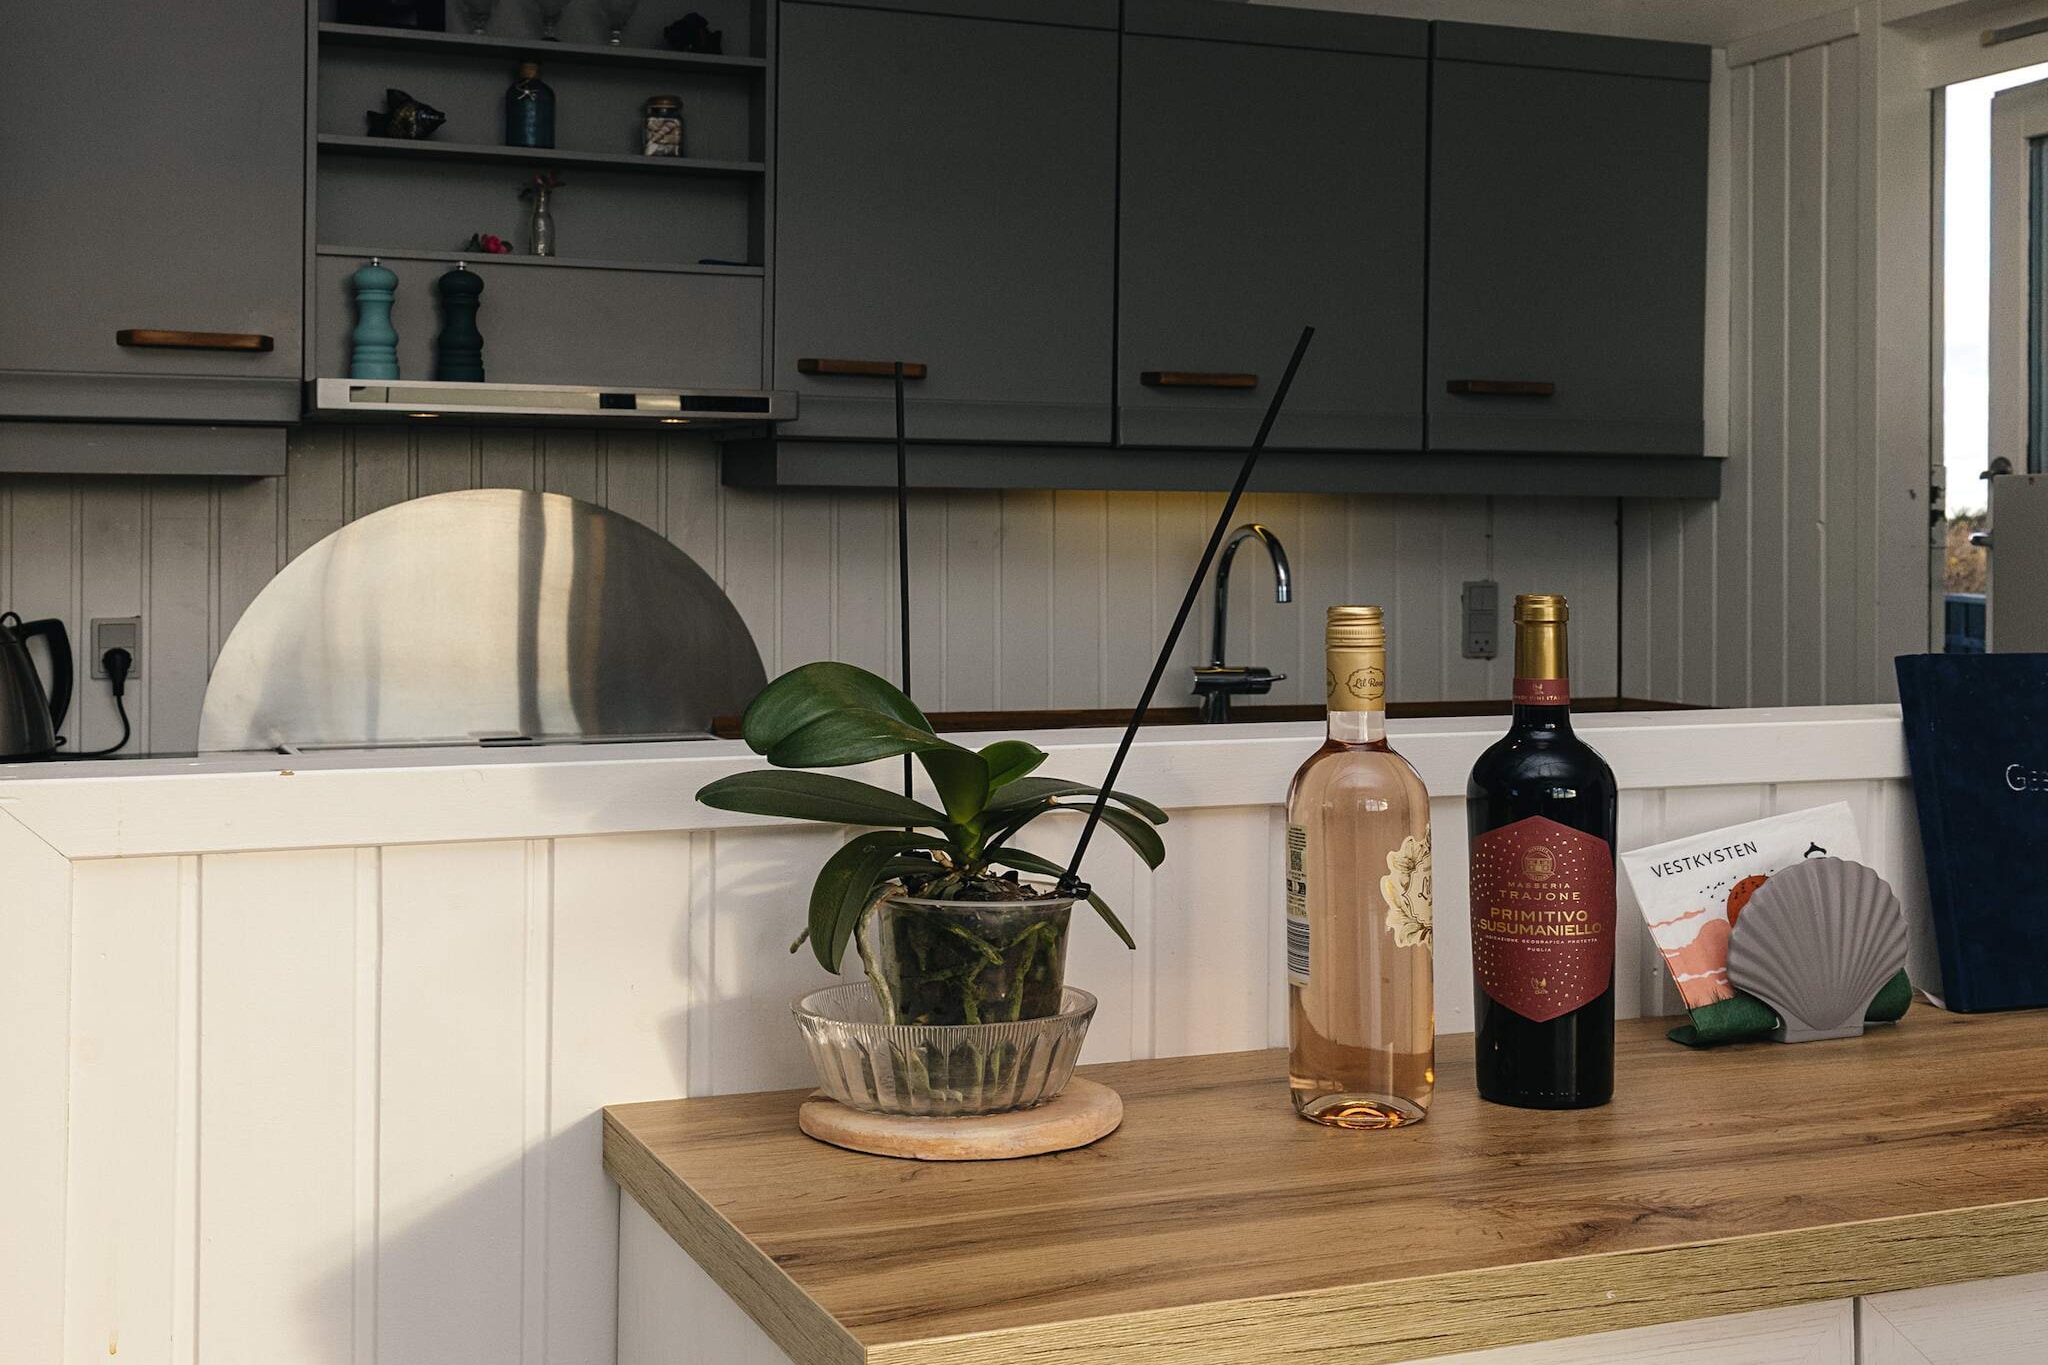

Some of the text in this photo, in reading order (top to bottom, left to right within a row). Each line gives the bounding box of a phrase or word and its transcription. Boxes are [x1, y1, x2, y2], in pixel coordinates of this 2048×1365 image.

[1650, 841, 1758, 878] VESTKYSTEN
[1507, 881, 1571, 889] MASSERIA
[1499, 889, 1581, 901] TRAJONE
[1490, 907, 1588, 923] PRIMITIVO
[1480, 918, 1601, 937] SUSUMANIELLO
